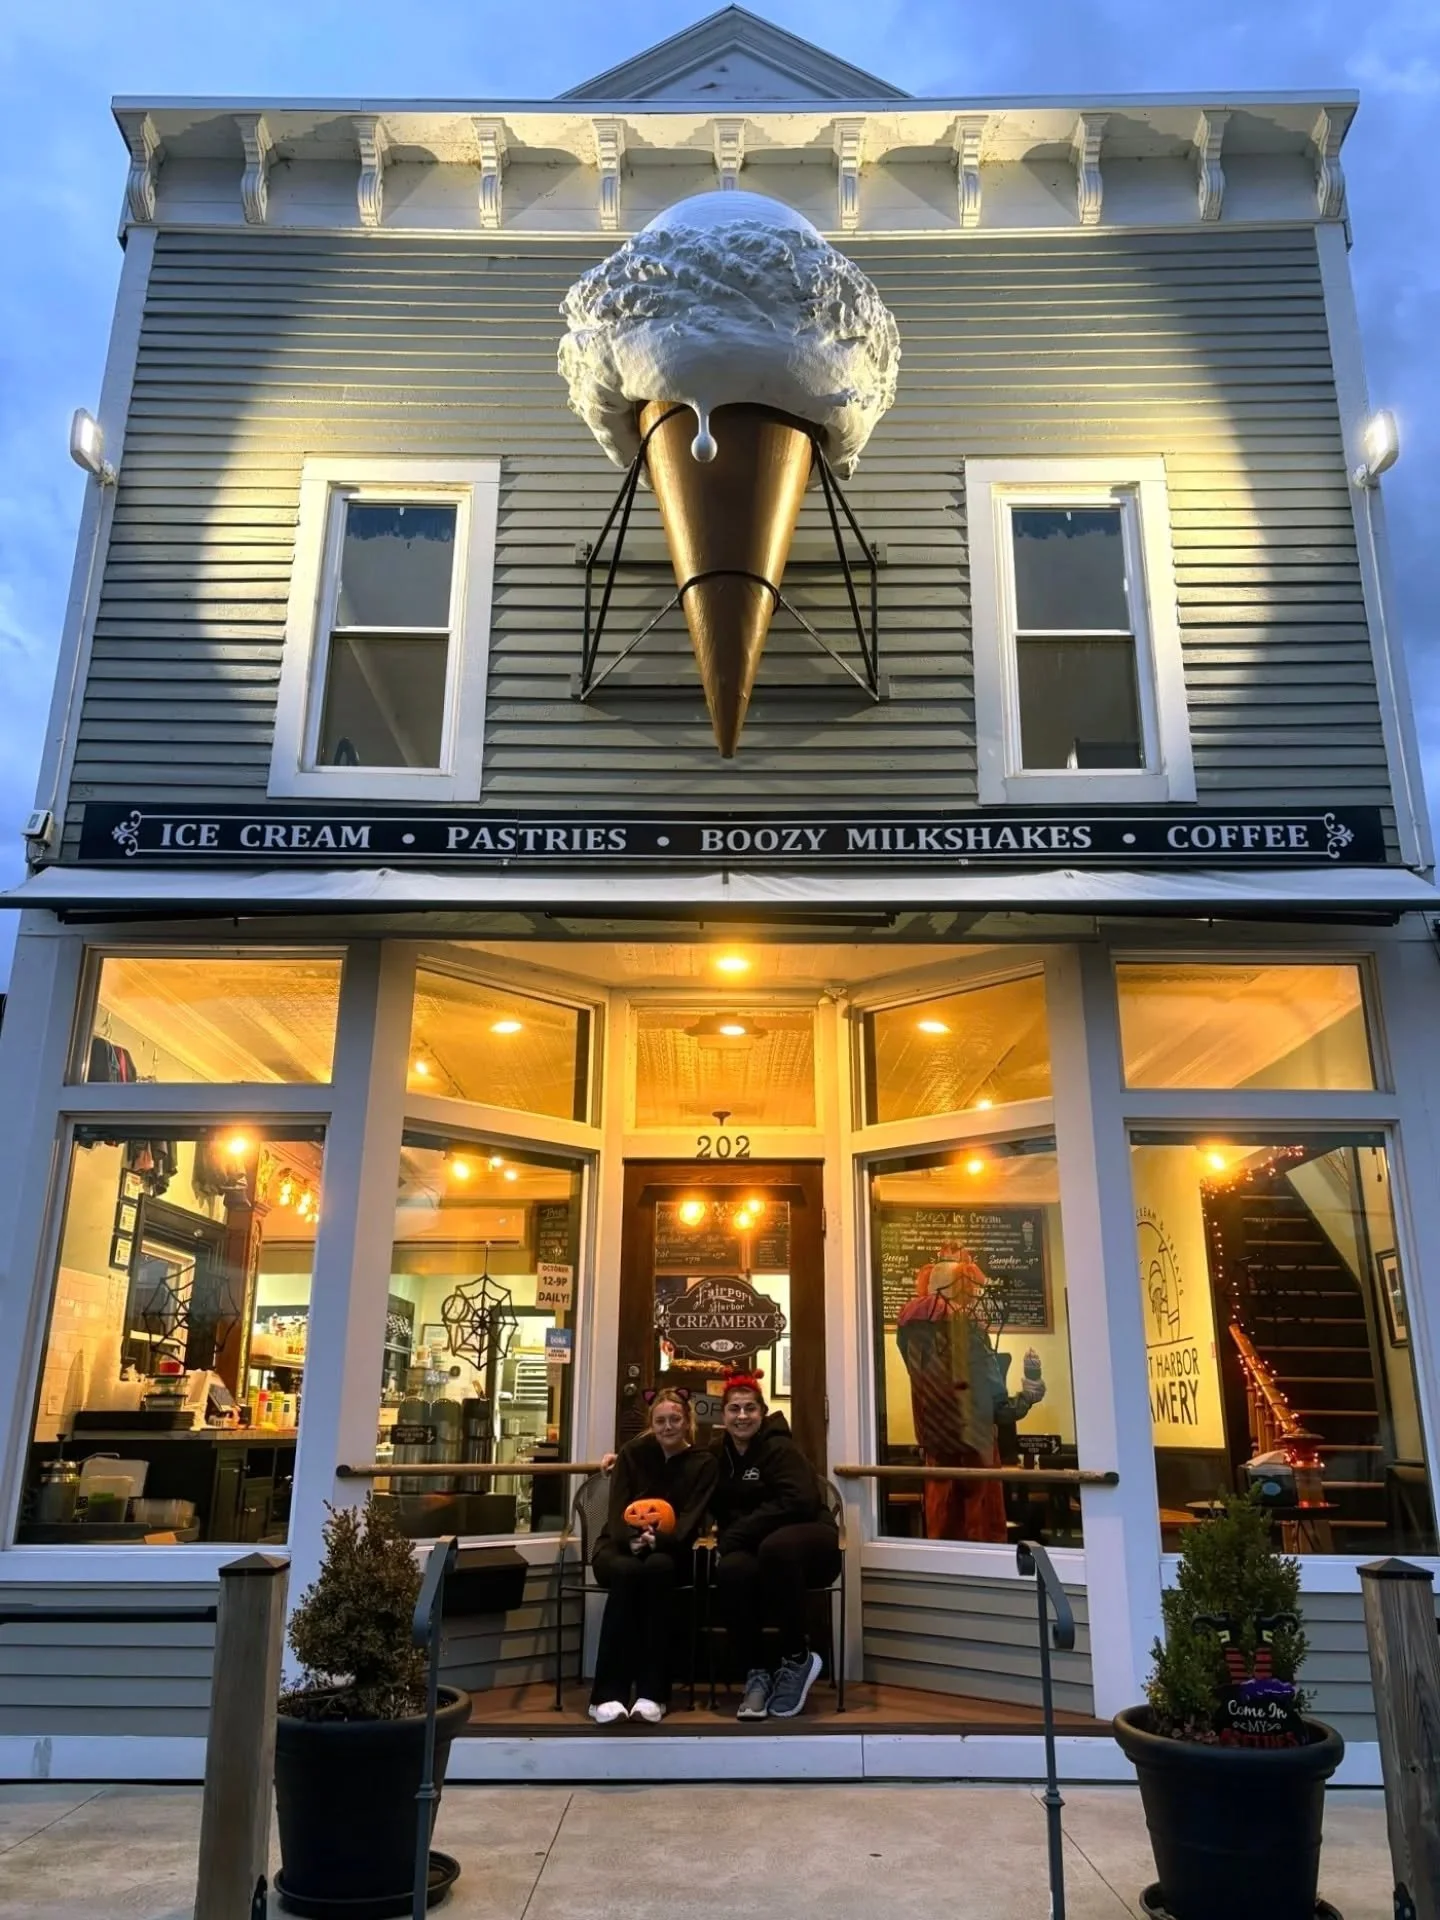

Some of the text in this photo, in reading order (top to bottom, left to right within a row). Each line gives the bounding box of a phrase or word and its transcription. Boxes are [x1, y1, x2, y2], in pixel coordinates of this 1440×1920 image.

[161, 823, 1309, 851] ICE CREAM PASTRIES BOOZY MILKSHAKES COFFEE
[696, 1135, 750, 1160] 202
[543, 1276, 568, 1287] 12-9P
[538, 1291, 570, 1304] DAILY!
[694, 1282, 754, 1310] Fairport
[675, 1315, 769, 1328] CREAMERY
[1156, 1347, 1200, 1379] HARBOR
[1228, 1700, 1287, 1719] Come In
[1248, 1720, 1268, 1733] MY
